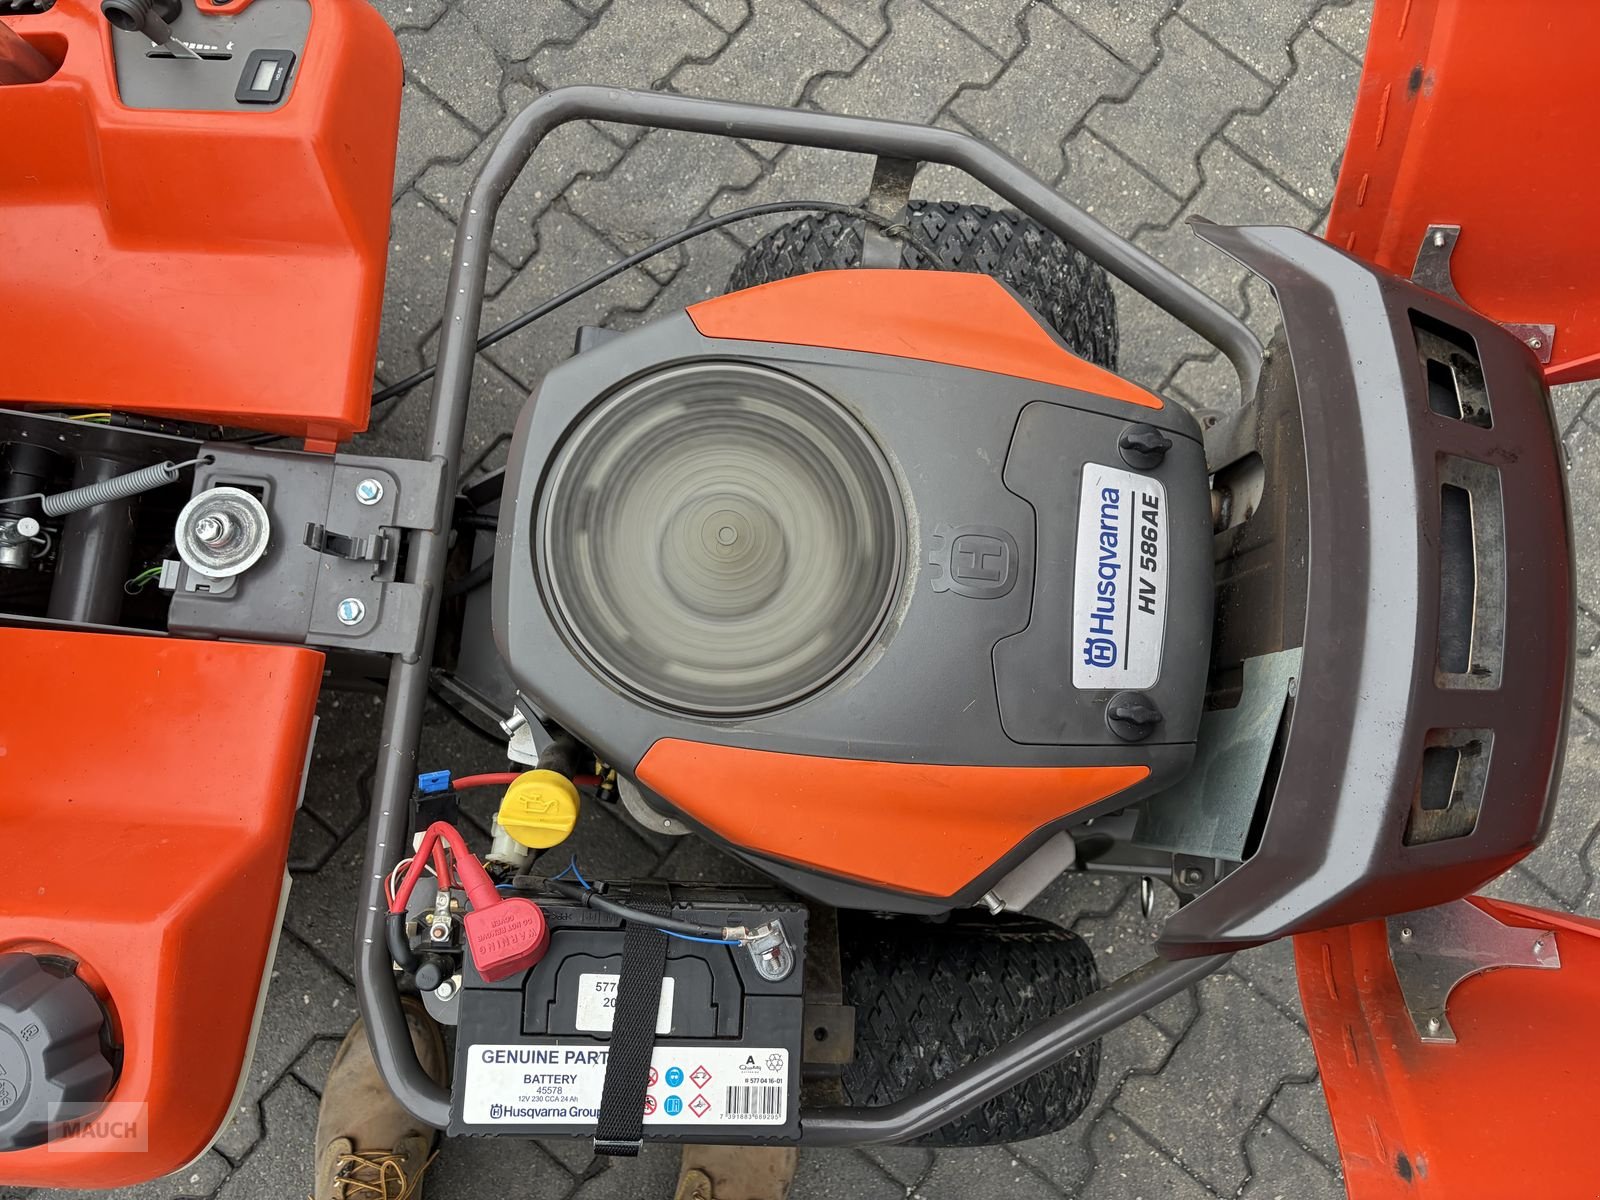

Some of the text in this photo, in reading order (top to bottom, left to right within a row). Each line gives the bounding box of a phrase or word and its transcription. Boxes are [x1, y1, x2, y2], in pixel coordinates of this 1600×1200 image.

[1138, 492, 1159, 615] HV 586AE
[1089, 487, 1121, 635] Husqvarna
[481, 1049, 560, 1064] GENUINE
[745, 1055, 756, 1065] A
[523, 1074, 578, 1084] BATTERY
[536, 1086, 563, 1095] 45578
[503, 1106, 566, 1120] Husqvarna
